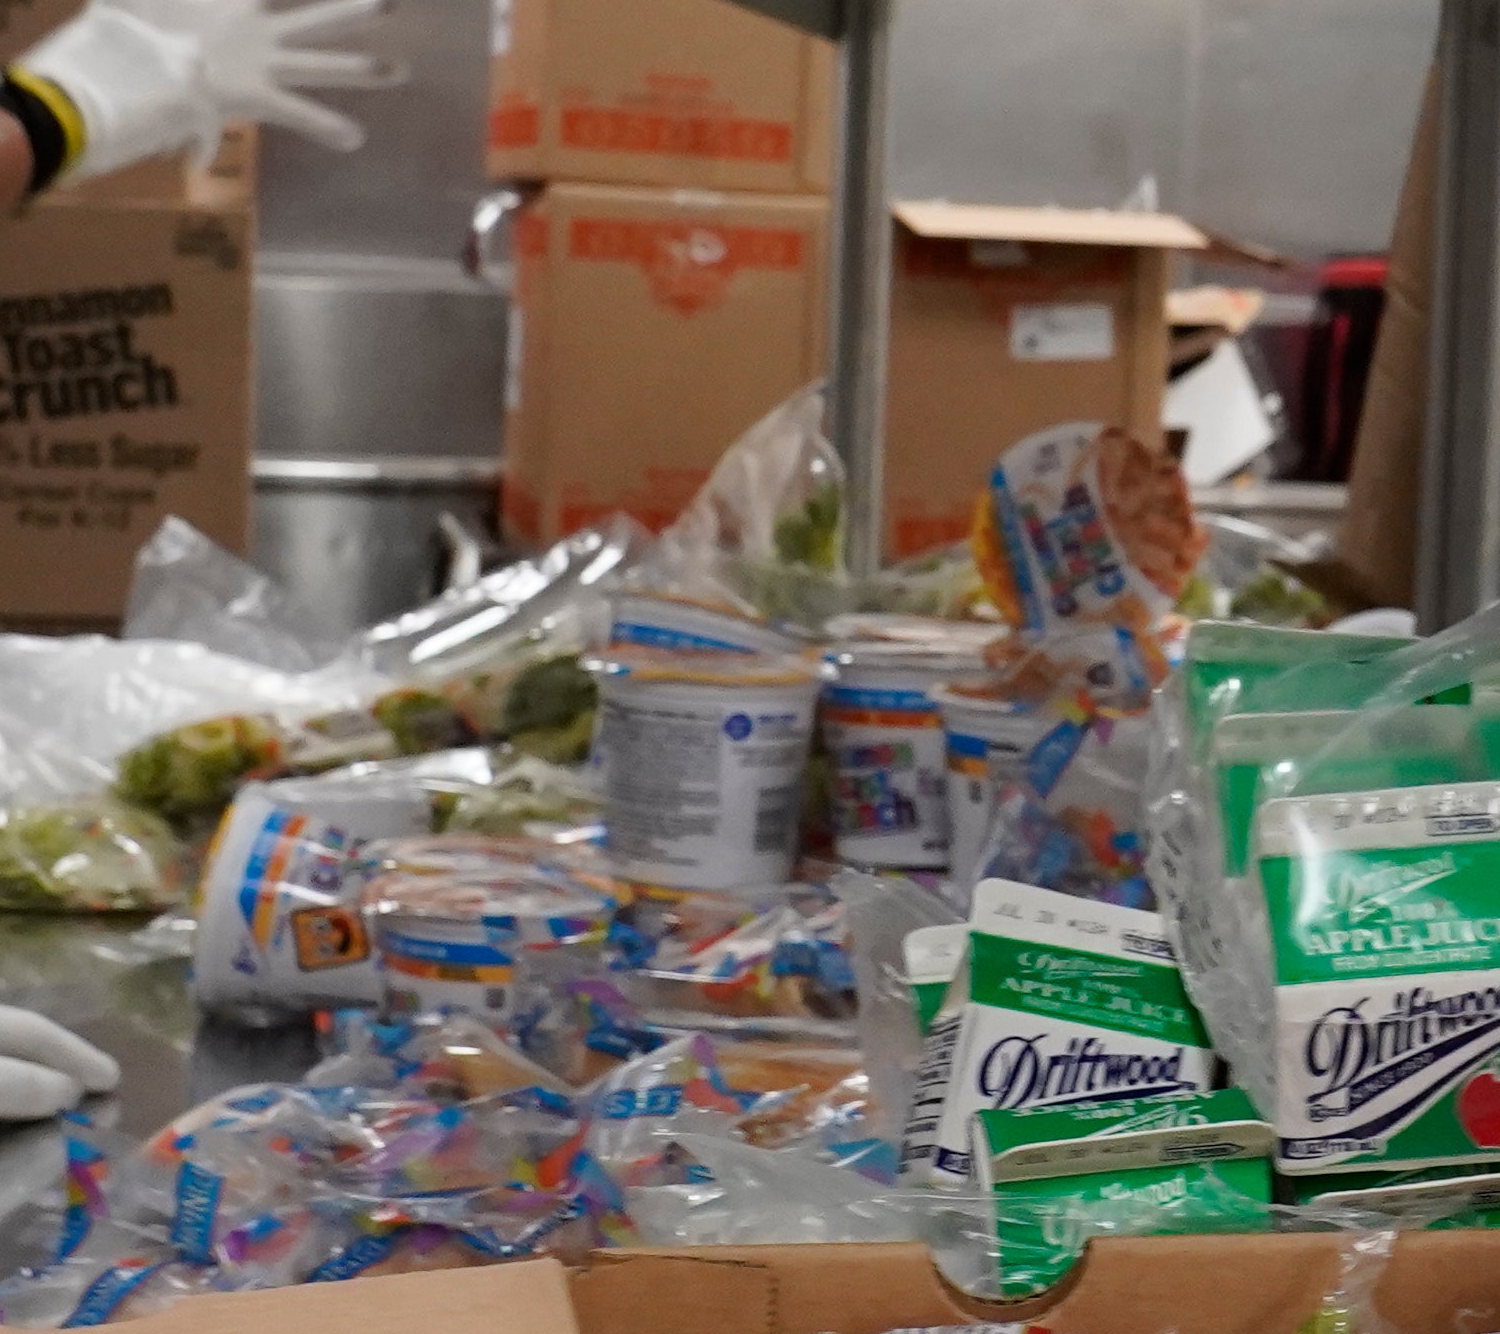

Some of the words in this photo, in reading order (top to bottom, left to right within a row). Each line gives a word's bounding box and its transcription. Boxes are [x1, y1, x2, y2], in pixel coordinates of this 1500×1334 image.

[3, 319, 140, 372] Toast
[29, 436, 99, 468] Less
[110, 434, 200, 475] Sugar
[1305, 924, 1412, 955] APPLE
[978, 1033, 1184, 1110] Driftwood
